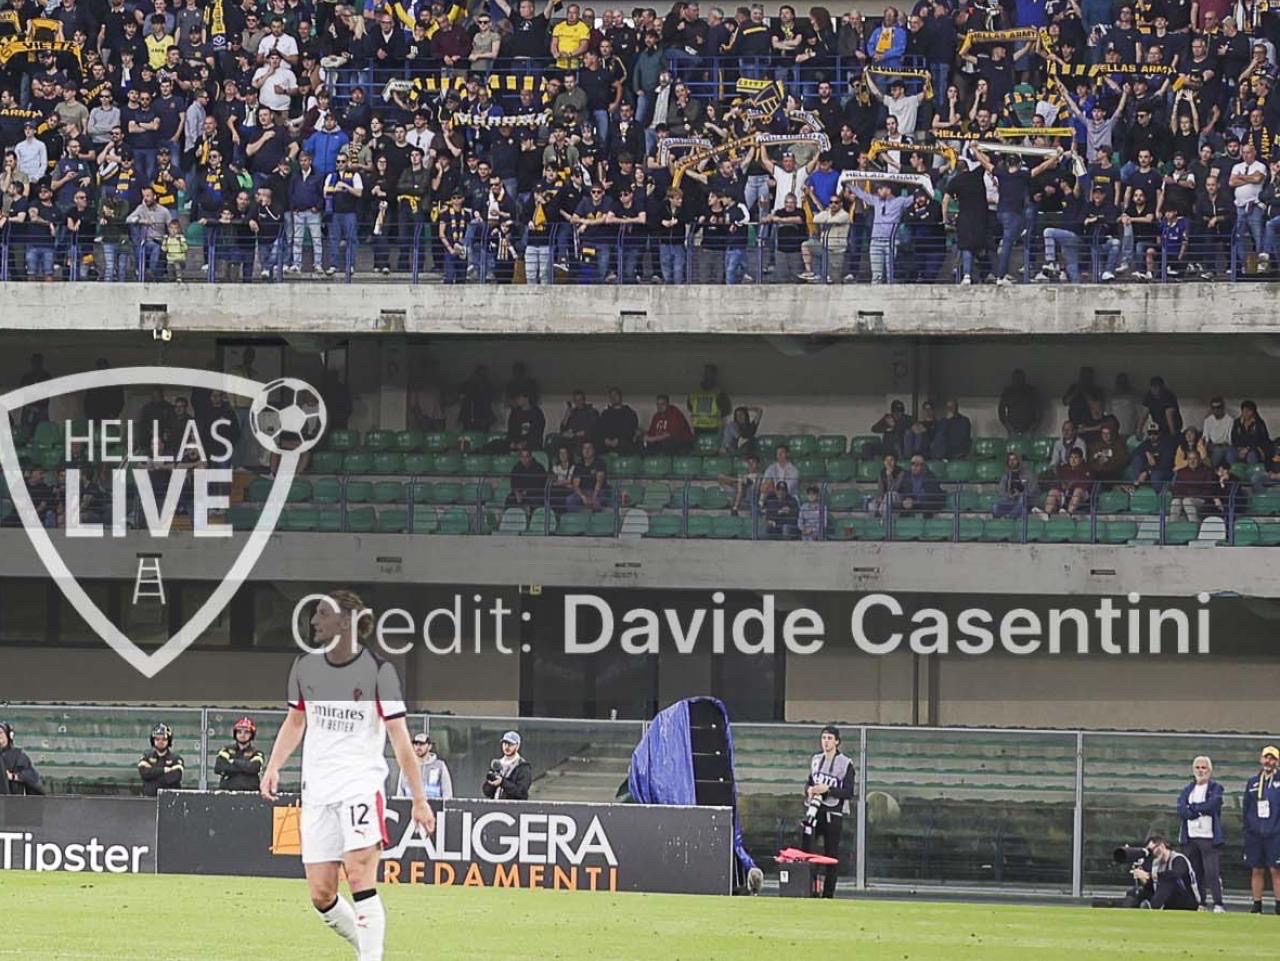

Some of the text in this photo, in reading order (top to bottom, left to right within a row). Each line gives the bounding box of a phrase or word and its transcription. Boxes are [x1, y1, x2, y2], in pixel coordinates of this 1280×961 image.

[972, 30, 1037, 40] HELLAS ARMY
[0, 108, 43, 118] ARMY
[935, 128, 981, 139] HELLAS
[845, 172, 920, 182] HELLAS ARMY
[348, 803, 370, 829] 12
